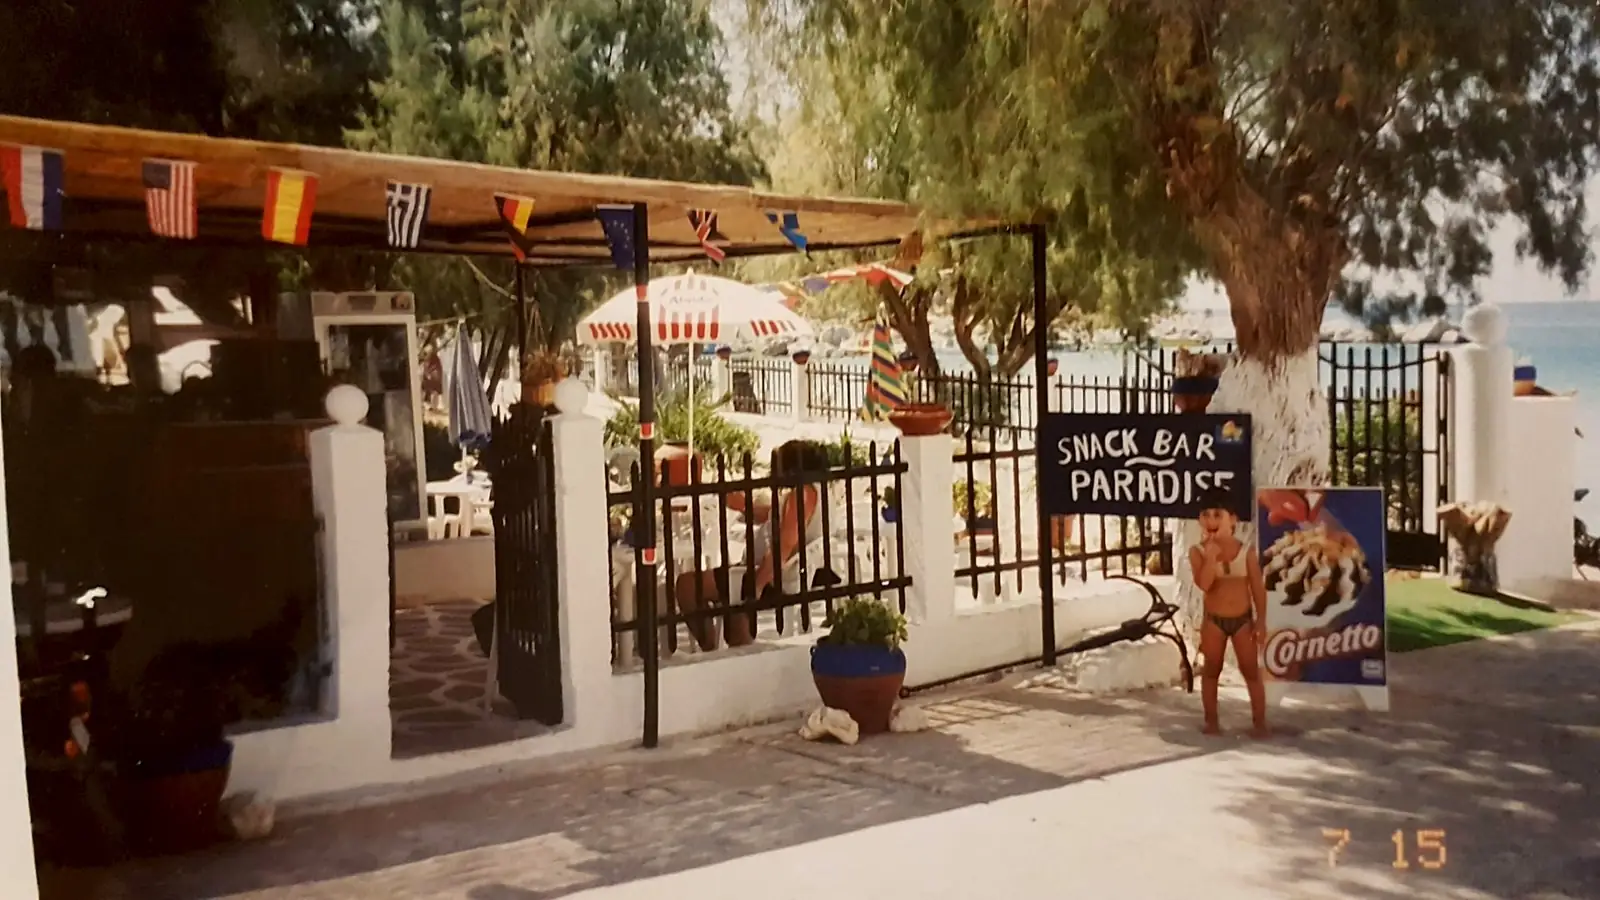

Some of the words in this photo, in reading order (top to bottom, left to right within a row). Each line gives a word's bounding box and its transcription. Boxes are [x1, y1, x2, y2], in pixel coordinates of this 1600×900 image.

[1057, 428, 1139, 466] SNACK
[1152, 428, 1216, 461] BAR
[1265, 623, 1380, 676] Cornetto
